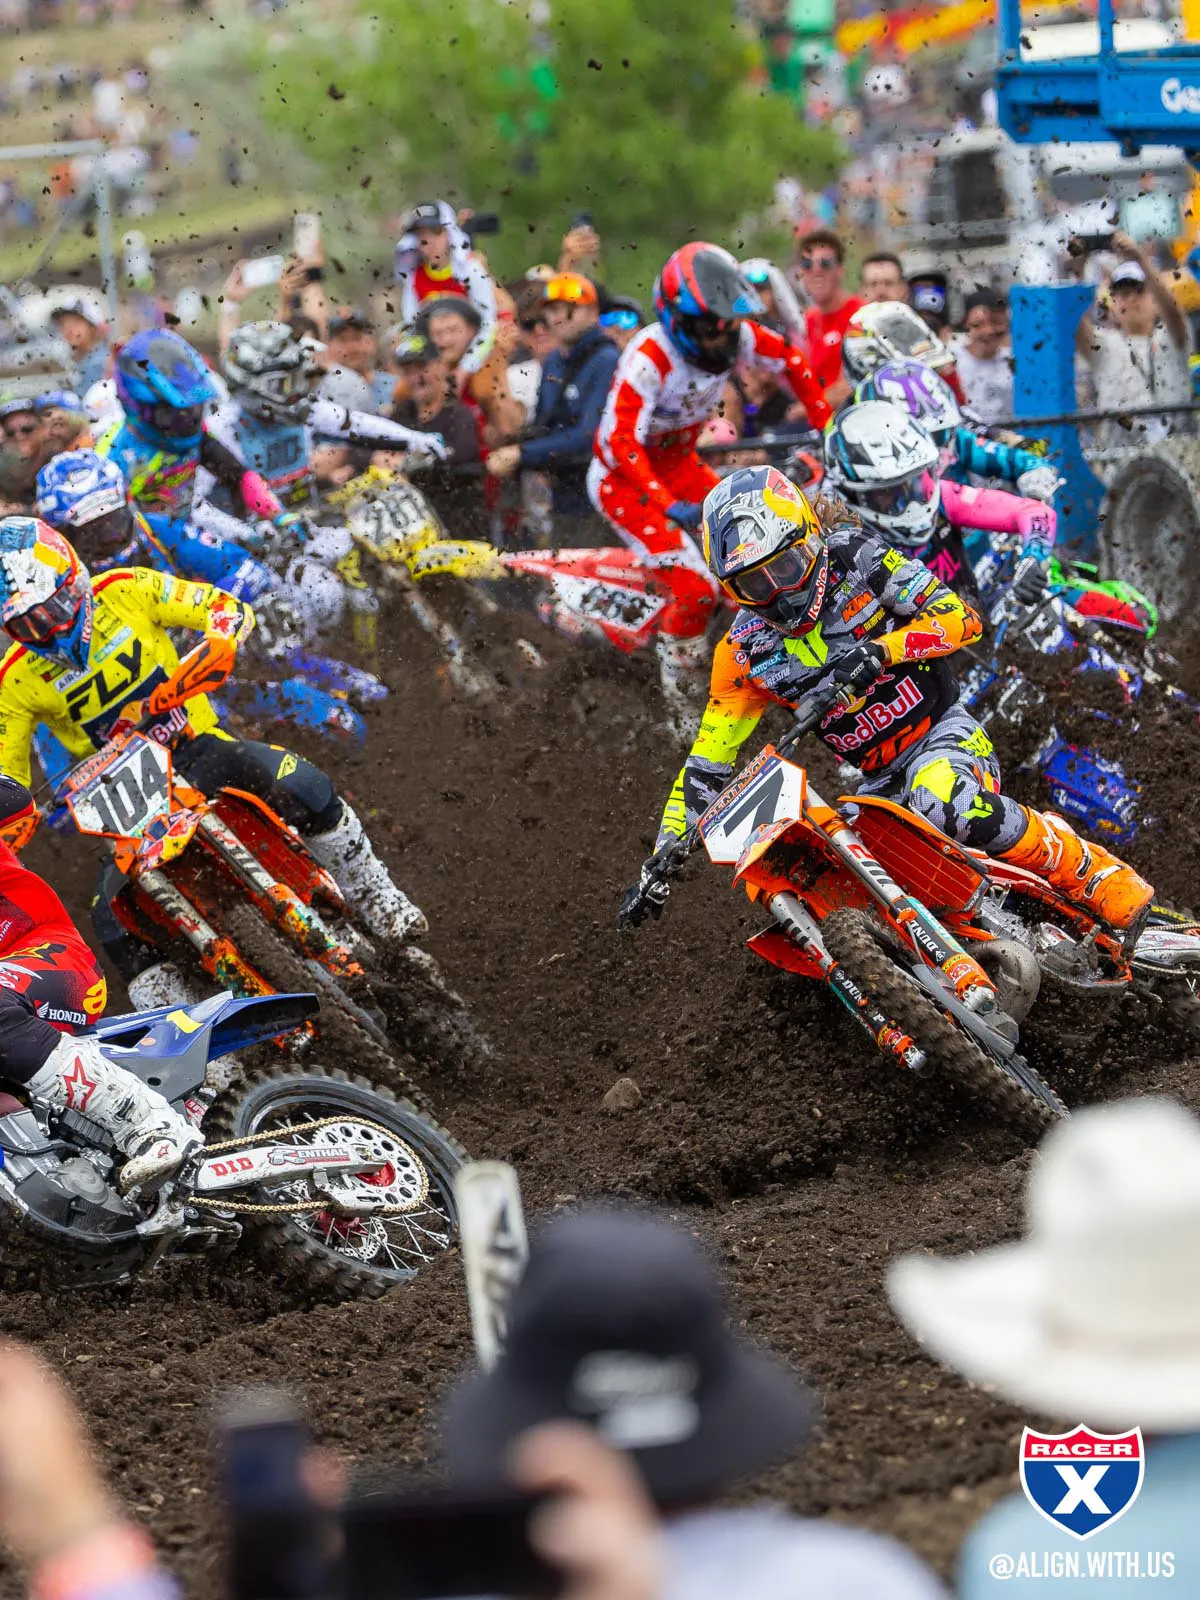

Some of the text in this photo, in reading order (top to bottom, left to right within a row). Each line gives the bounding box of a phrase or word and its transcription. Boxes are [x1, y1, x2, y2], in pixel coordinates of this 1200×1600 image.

[841, 591, 874, 623] KTM
[66, 638, 143, 722] FLY
[91, 746, 168, 834] 104
[723, 767, 784, 838] 7
[910, 919, 938, 953] DUNL
[49, 1008, 87, 1026] HONDA
